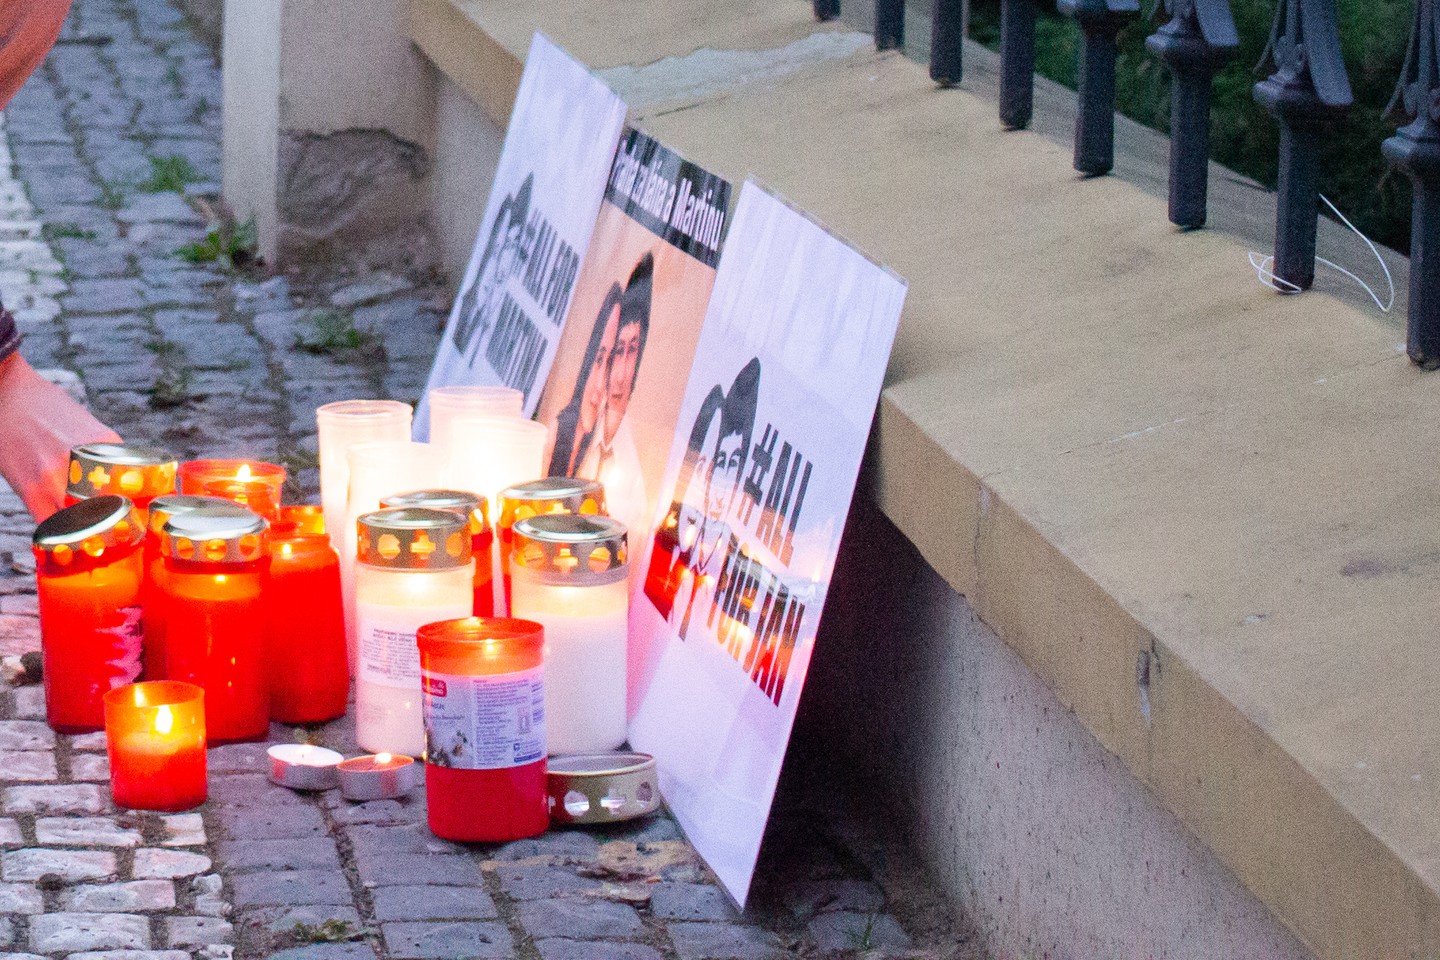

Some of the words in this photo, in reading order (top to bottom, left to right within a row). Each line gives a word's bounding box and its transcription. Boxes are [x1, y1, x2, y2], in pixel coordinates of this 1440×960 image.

[513, 208, 558, 303] #ALL
[541, 239, 580, 328] FOR
[671, 177, 725, 252] Martinu
[736, 423, 813, 568] #ALL
[707, 532, 760, 662] FOR
[743, 573, 806, 707] JAN
